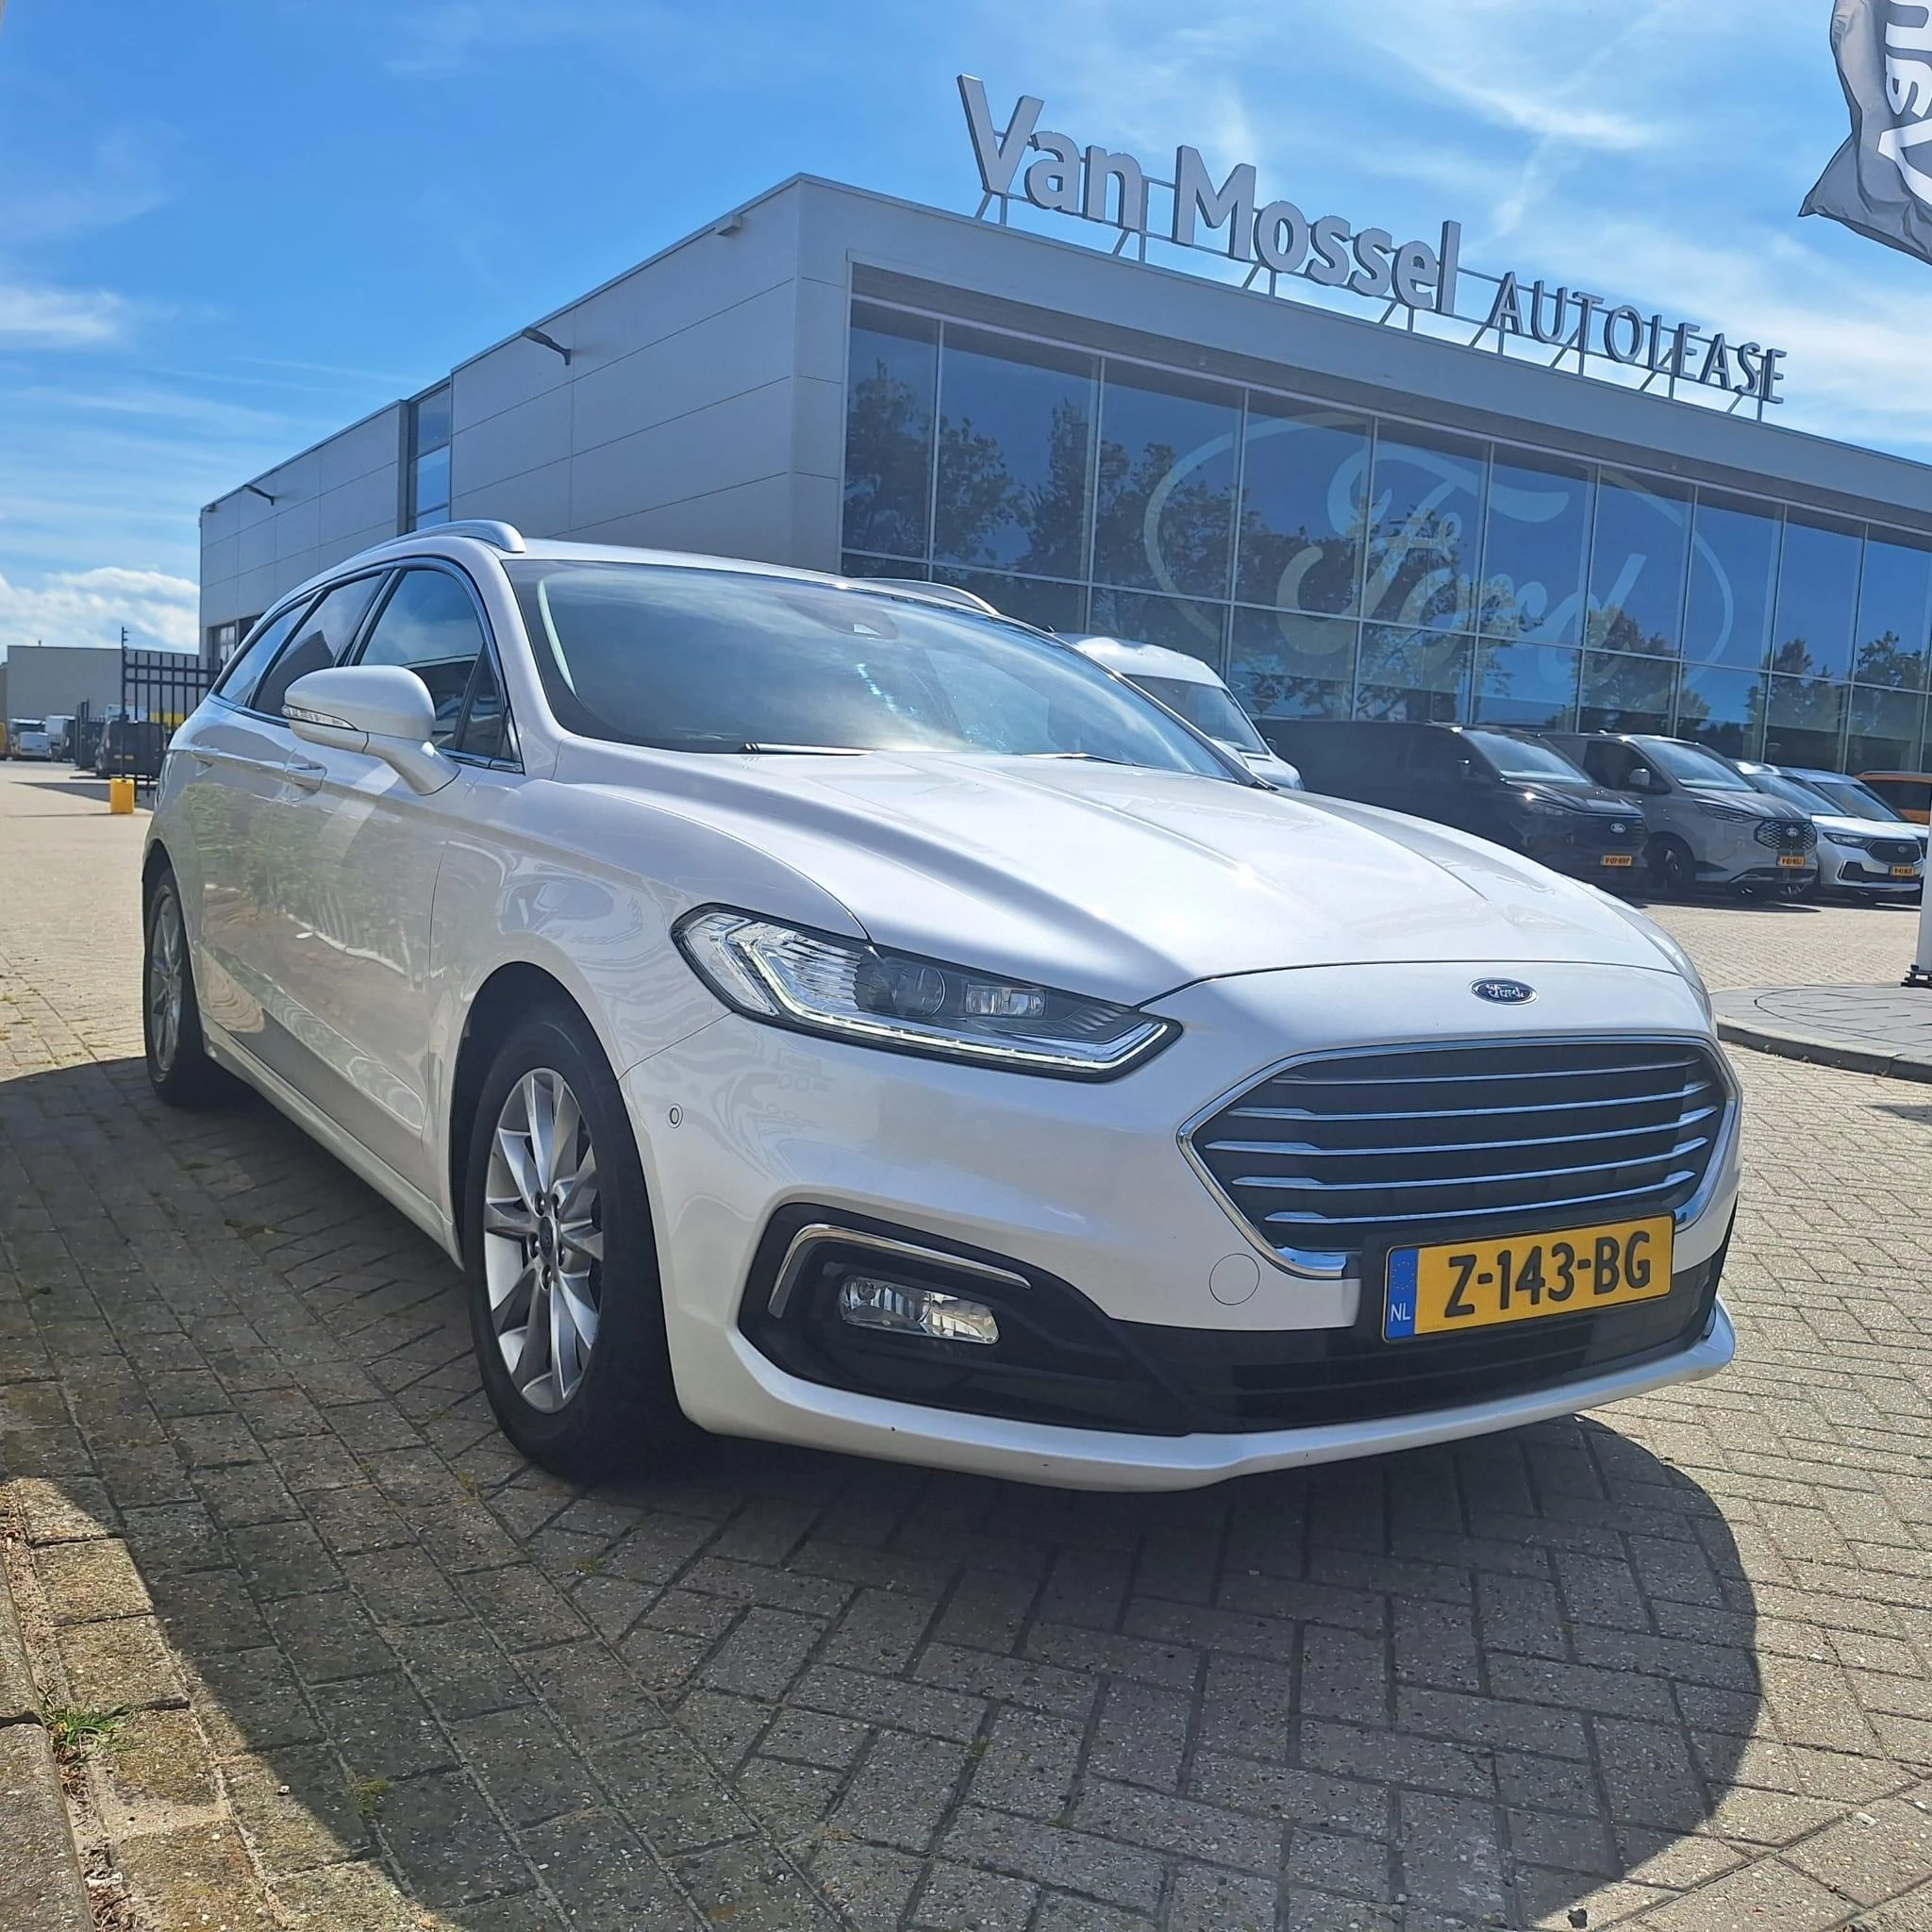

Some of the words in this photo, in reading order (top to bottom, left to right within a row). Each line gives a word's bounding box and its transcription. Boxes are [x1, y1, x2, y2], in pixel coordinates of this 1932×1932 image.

[957, 74, 1142, 231] Van
[1171, 144, 1461, 315] Mossel
[1486, 271, 1788, 405] AUTOLEASE
[1276, 444, 1648, 686] Ford
[1485, 984, 1524, 998] Ford
[1390, 1302, 1411, 1323] NL
[1443, 1230, 1651, 1319] Z-143-BG
